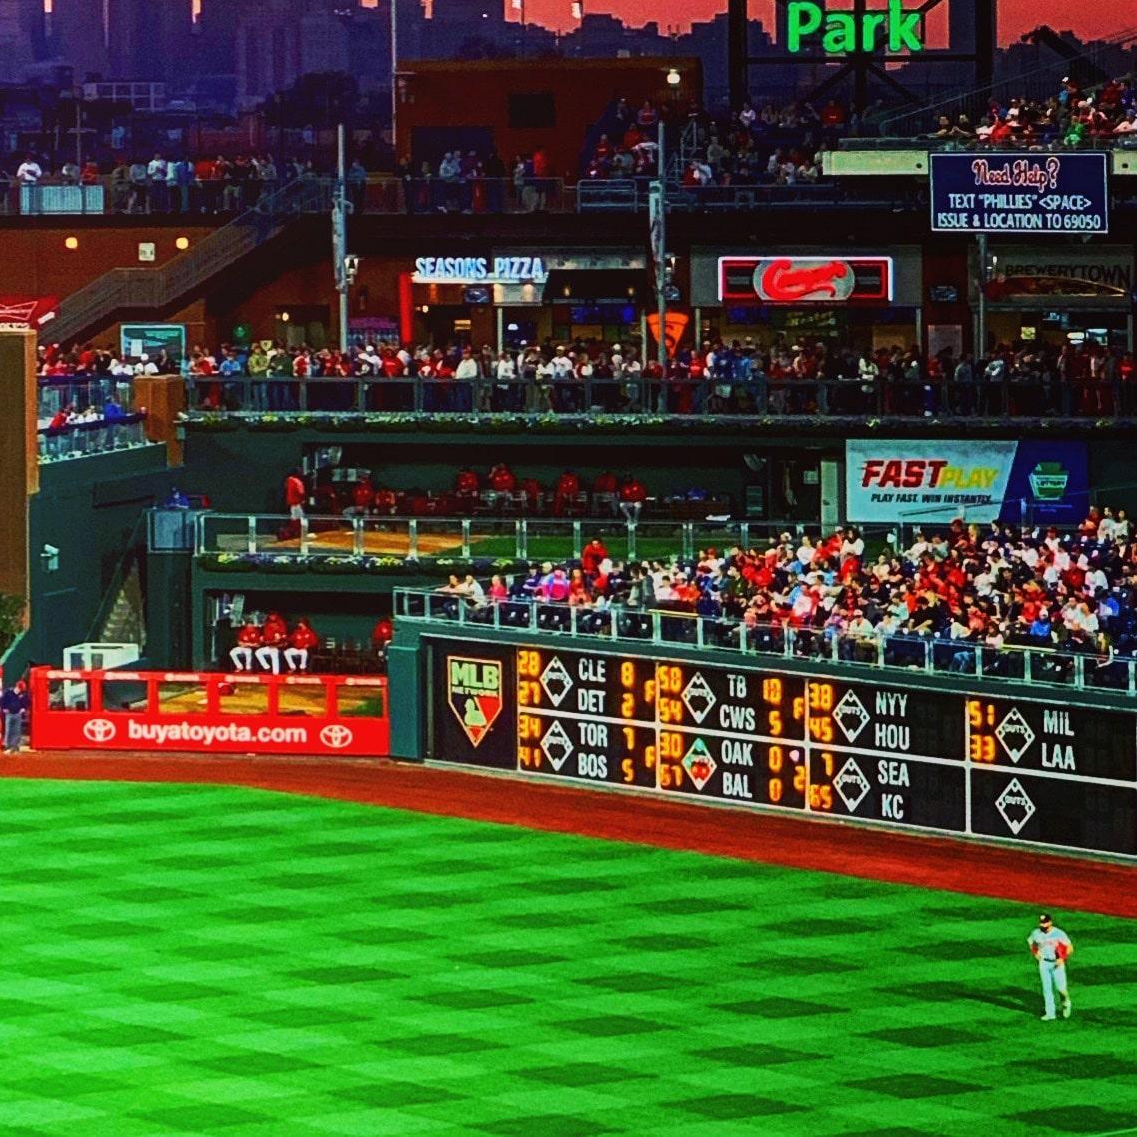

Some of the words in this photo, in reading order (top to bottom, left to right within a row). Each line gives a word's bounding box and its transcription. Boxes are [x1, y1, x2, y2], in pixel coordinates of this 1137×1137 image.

[972, 159, 1011, 185] Need
[1013, 156, 1060, 193] Help?
[948, 194, 975, 208] TEXT
[978, 193, 1037, 209] "PHILLIES"
[1039, 195, 1092, 210] <SPACE>
[938, 213, 968, 227] ISSUE
[972, 214, 981, 227] &
[984, 213, 1043, 228] LOCATION
[1046, 214, 1062, 228] TO
[1064, 214, 1101, 229] 69050
[415, 257, 487, 279] SEASONS
[494, 257, 544, 279] PIZZA
[1005, 264, 1131, 286] BREWERYTOWN
[861, 460, 949, 488] FAST
[871, 494, 893, 503] PLAY
[921, 494, 941, 503] WIN
[451, 662, 499, 689] MLB
[519, 650, 540, 677] 28
[578, 658, 606, 682] CLE
[621, 661, 634, 687] 8
[644, 680, 655, 702] F
[727, 674, 747, 698] TB
[578, 688, 606, 713] DET
[621, 693, 634, 717] 2
[793, 697, 805, 720] F
[876, 691, 908, 717] NYY
[719, 704, 756, 731] CWS
[769, 710, 782, 735] 5
[969, 701, 995, 727] 51
[1044, 709, 1074, 736] MIL
[128, 720, 307, 746] buyatoyota.com
[578, 722, 608, 748] TOR
[623, 727, 634, 750] 7
[875, 723, 910, 750] HOU
[645, 746, 655, 768] F
[721, 740, 753, 767] OAK
[769, 746, 782, 772] 0
[970, 734, 995, 761] 33
[1042, 743, 1075, 770] LAA
[578, 753, 608, 779] BOS
[622, 759, 634, 782] 5
[794, 765, 806, 791] 2
[878, 760, 910, 787] SEA
[723, 771, 753, 798] BAL
[769, 777, 782, 802] 0
[882, 793, 903, 820] KC
